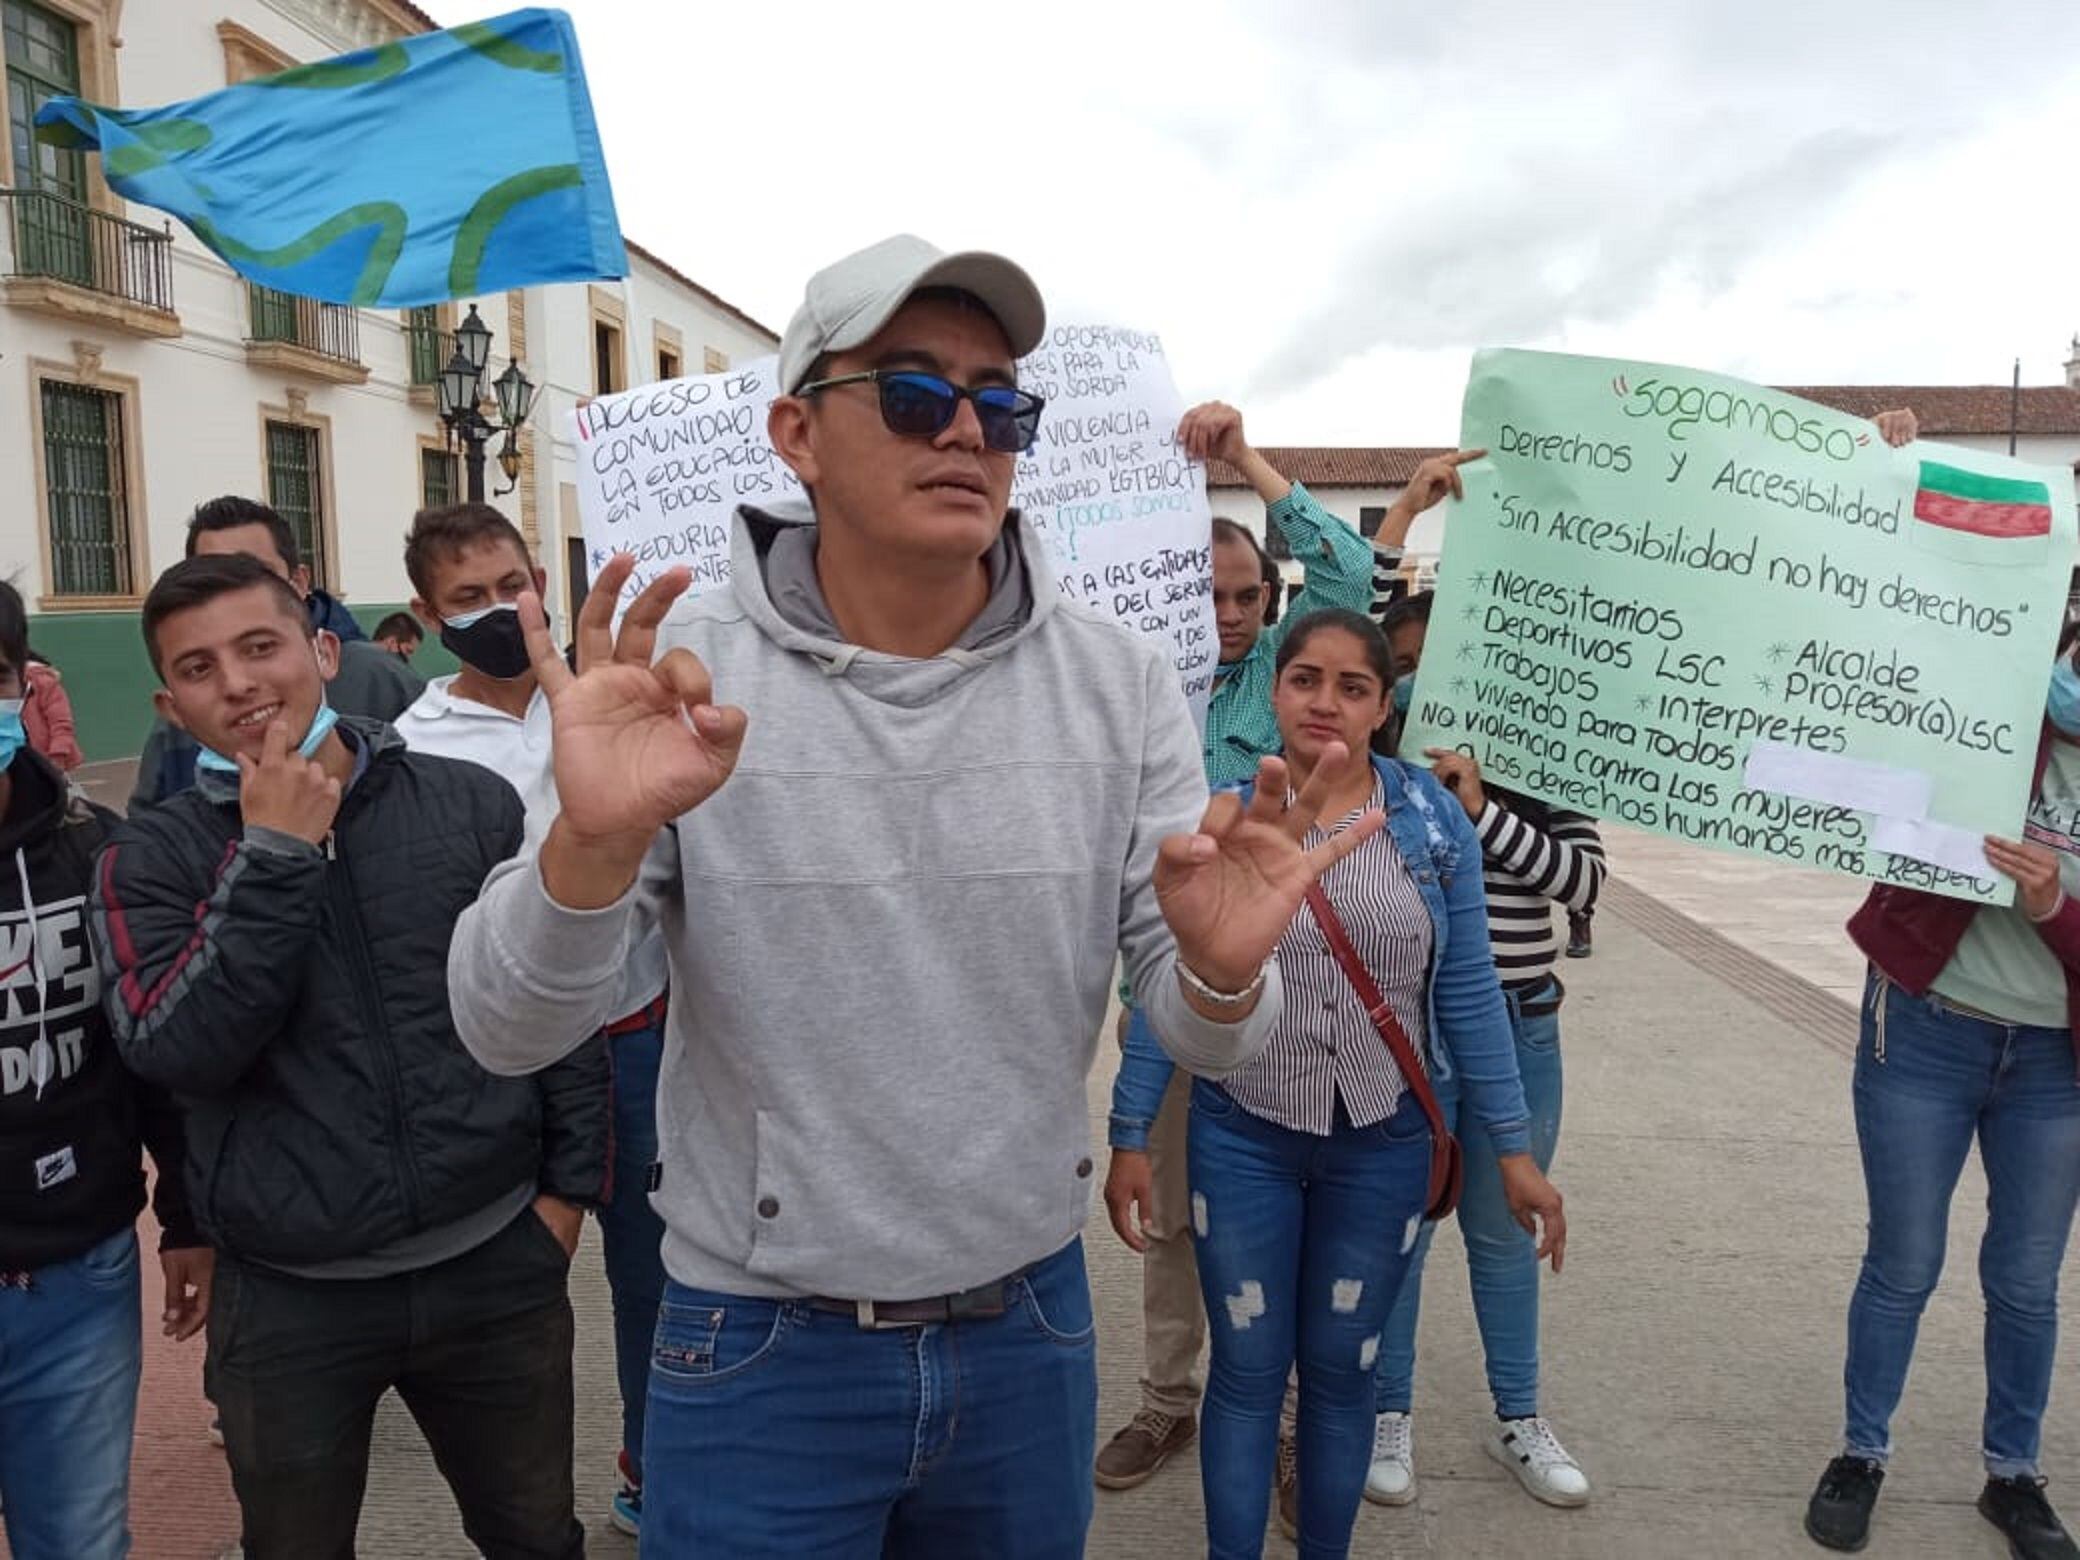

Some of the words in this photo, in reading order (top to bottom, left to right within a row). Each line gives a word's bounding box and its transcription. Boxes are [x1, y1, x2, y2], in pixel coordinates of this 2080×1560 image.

[724, 370, 761, 400] DE
[593, 404, 753, 475] COMUNIDAD
[1045, 408, 1151, 449] VIOLENCIA
[601, 468, 638, 502] LA
[607, 495, 641, 524] EN
[650, 479, 722, 519] TODOS
[732, 471, 773, 495] LOS
[1499, 423, 1632, 473] Derechos
[1711, 459, 1901, 534] Accesibilidad
[1547, 511, 1758, 576] Accesibilidad
[1769, 556, 1812, 588] no
[1820, 553, 1868, 608] hay
[1482, 642, 1600, 701] Trabajos
[1484, 605, 1632, 669] Deportivos
[1655, 646, 1726, 687] LSC
[1795, 639, 1920, 693] Alcalde
[1573, 748, 1660, 794] contra
[1525, 762, 1658, 826] derechos
[1665, 801, 1805, 859] humanos
